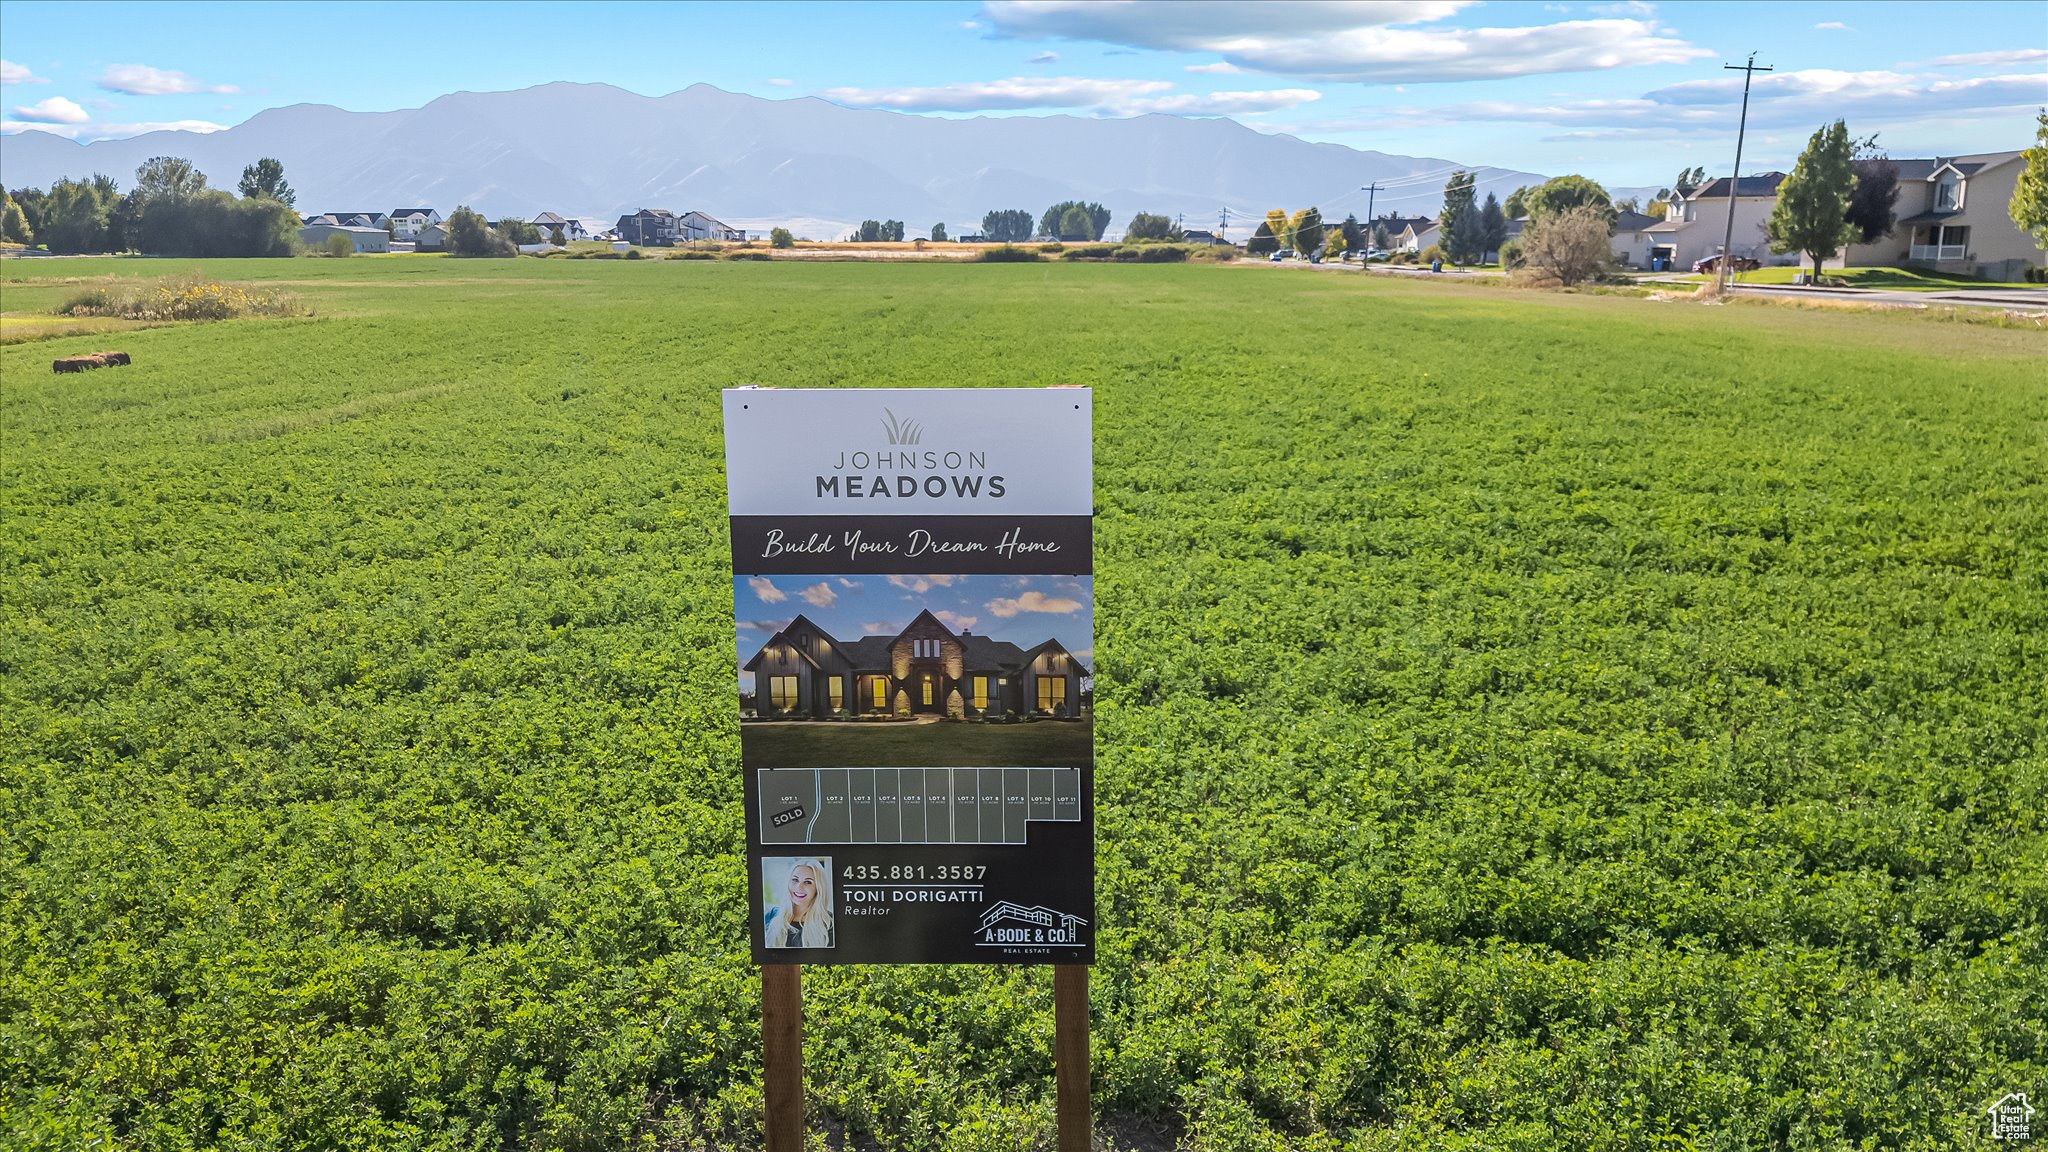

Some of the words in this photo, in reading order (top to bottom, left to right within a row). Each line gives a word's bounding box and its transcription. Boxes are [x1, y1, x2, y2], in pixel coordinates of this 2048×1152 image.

[833, 450, 987, 470] JOHNSON
[816, 475, 1007, 498] MEADOWS
[761, 529, 836, 558] Build
[843, 529, 898, 561] Your
[903, 529, 988, 557] Dream
[994, 527, 1062, 559] Home
[773, 808, 803, 825] SOLD
[843, 865, 987, 880] 435.881.3587
[843, 890, 885, 902] TONI
[892, 890, 983, 902] DORIGATTI
[844, 905, 891, 915] Realtor
[1035, 928, 1044, 943] &
[1047, 929, 1068, 943] CO.
